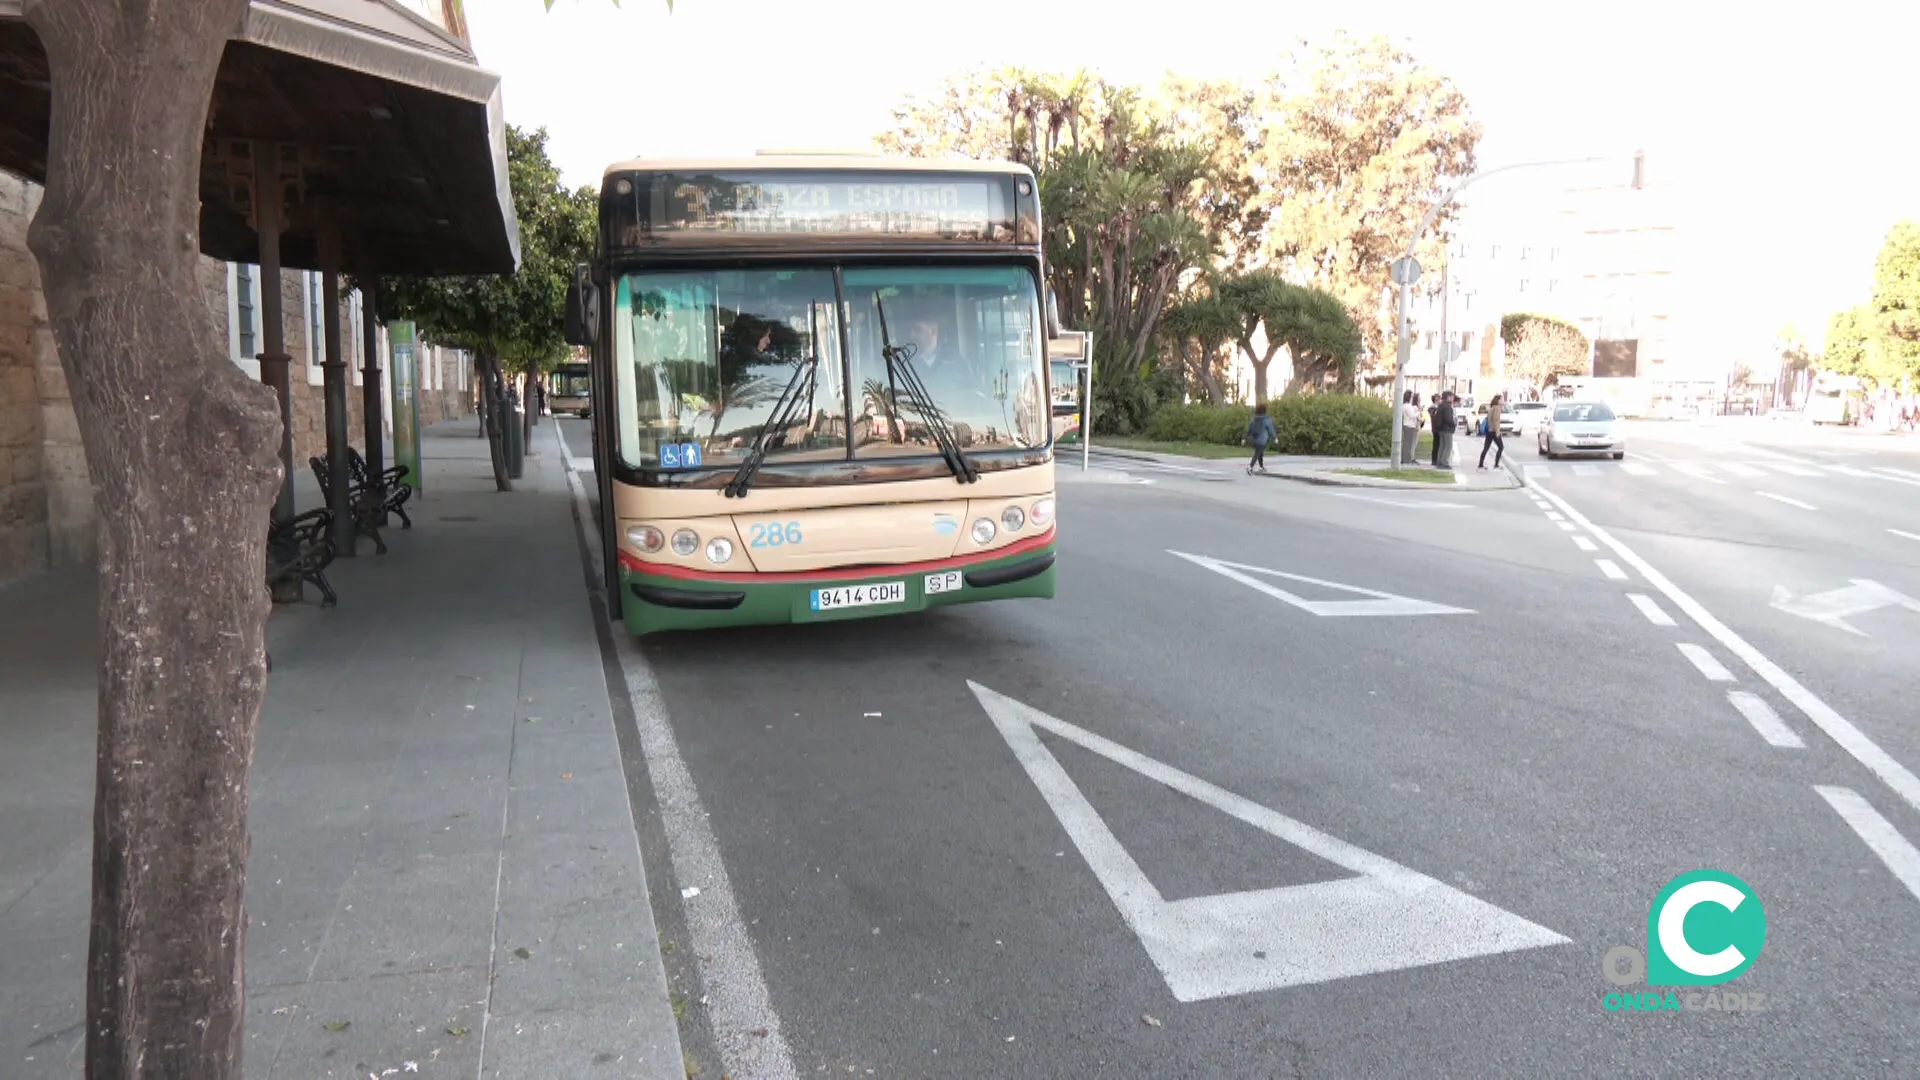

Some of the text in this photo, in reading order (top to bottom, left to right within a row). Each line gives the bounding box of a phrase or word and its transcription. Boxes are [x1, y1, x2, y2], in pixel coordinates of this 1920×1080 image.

[750, 521, 802, 548] 286
[821, 584, 899, 606] 9414 CDH
